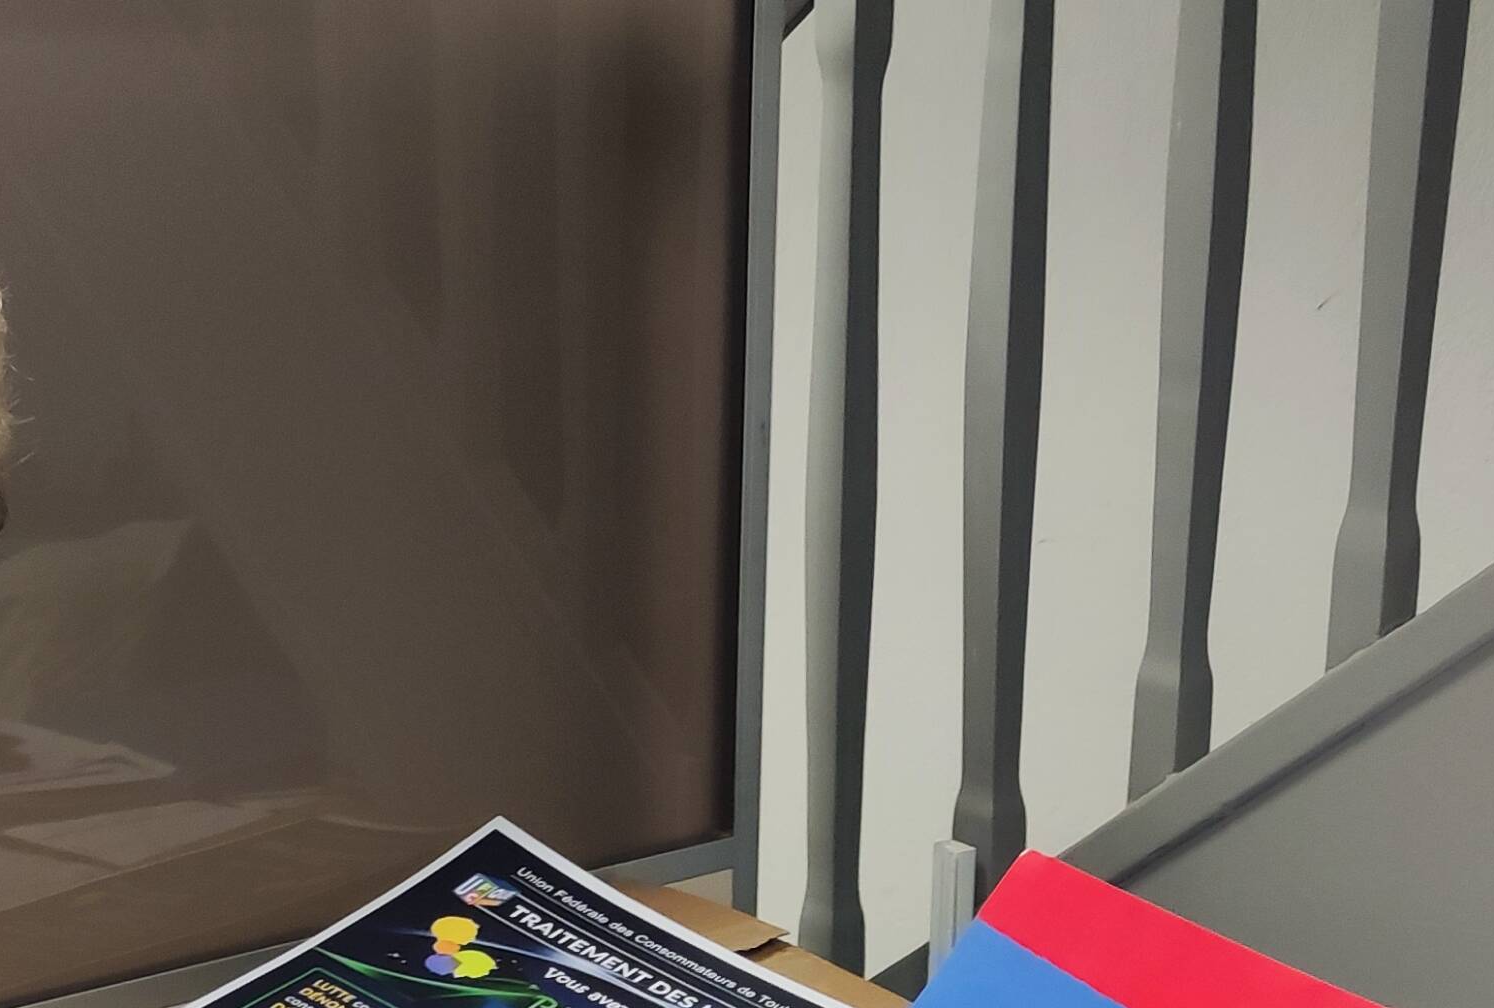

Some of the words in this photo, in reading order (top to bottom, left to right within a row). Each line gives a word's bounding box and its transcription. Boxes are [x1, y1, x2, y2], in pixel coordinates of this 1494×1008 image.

[510, 905, 653, 983] TRAITEMENT
[517, 867, 555, 893] Union
[553, 889, 609, 924] Fédérale
[608, 922, 634, 937] des
[634, 934, 737, 992] Consommateurs
[736, 986, 756, 998] de
[312, 979, 357, 1003] LUTTE
[544, 967, 590, 994] Vous
